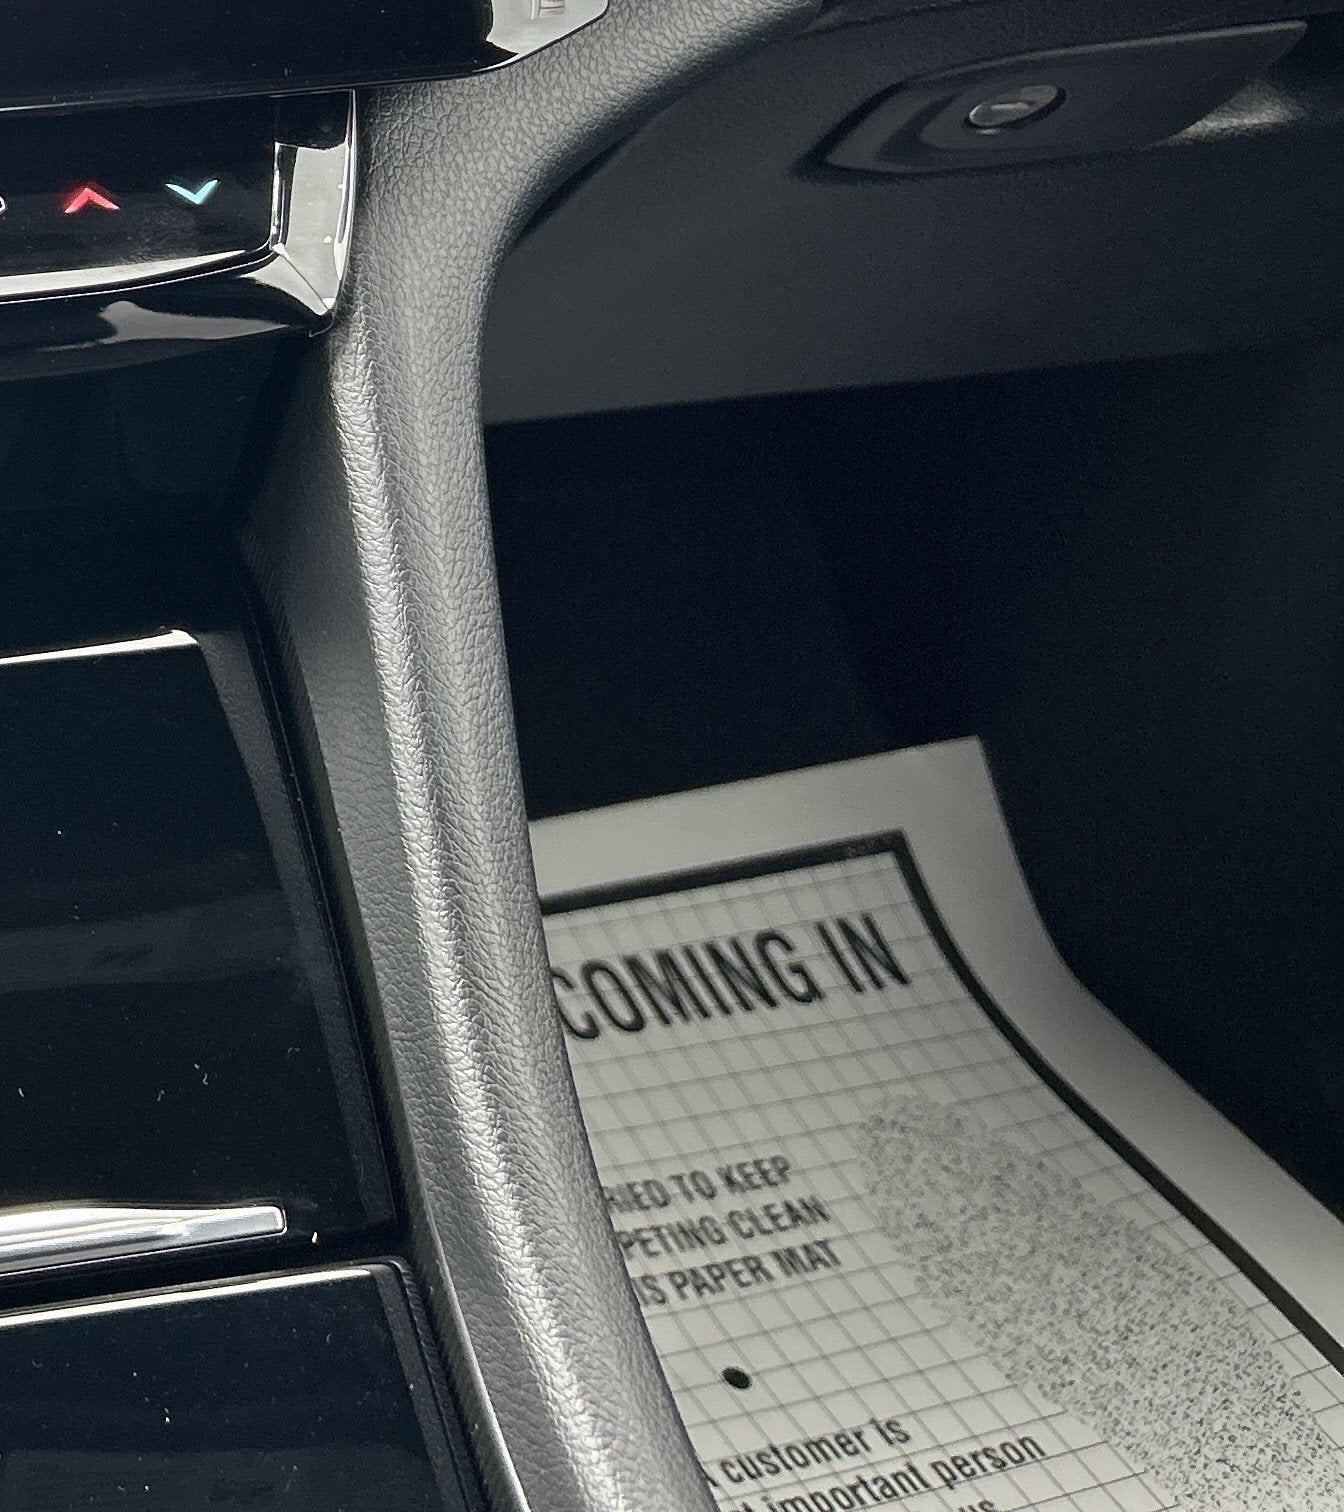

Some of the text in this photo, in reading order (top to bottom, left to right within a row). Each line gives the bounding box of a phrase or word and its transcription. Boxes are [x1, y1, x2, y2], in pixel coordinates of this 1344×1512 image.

[815, 912, 911, 993] IN
[670, 1170, 718, 1204] TO
[716, 1154, 791, 1193] KEEP
[727, 1194, 832, 1239] CLEAN
[666, 1254, 773, 1301] PAPER
[770, 1239, 842, 1277] MAT
[719, 1428, 872, 1485] customer
[869, 1417, 912, 1446] is
[930, 1433, 1047, 1491] person
